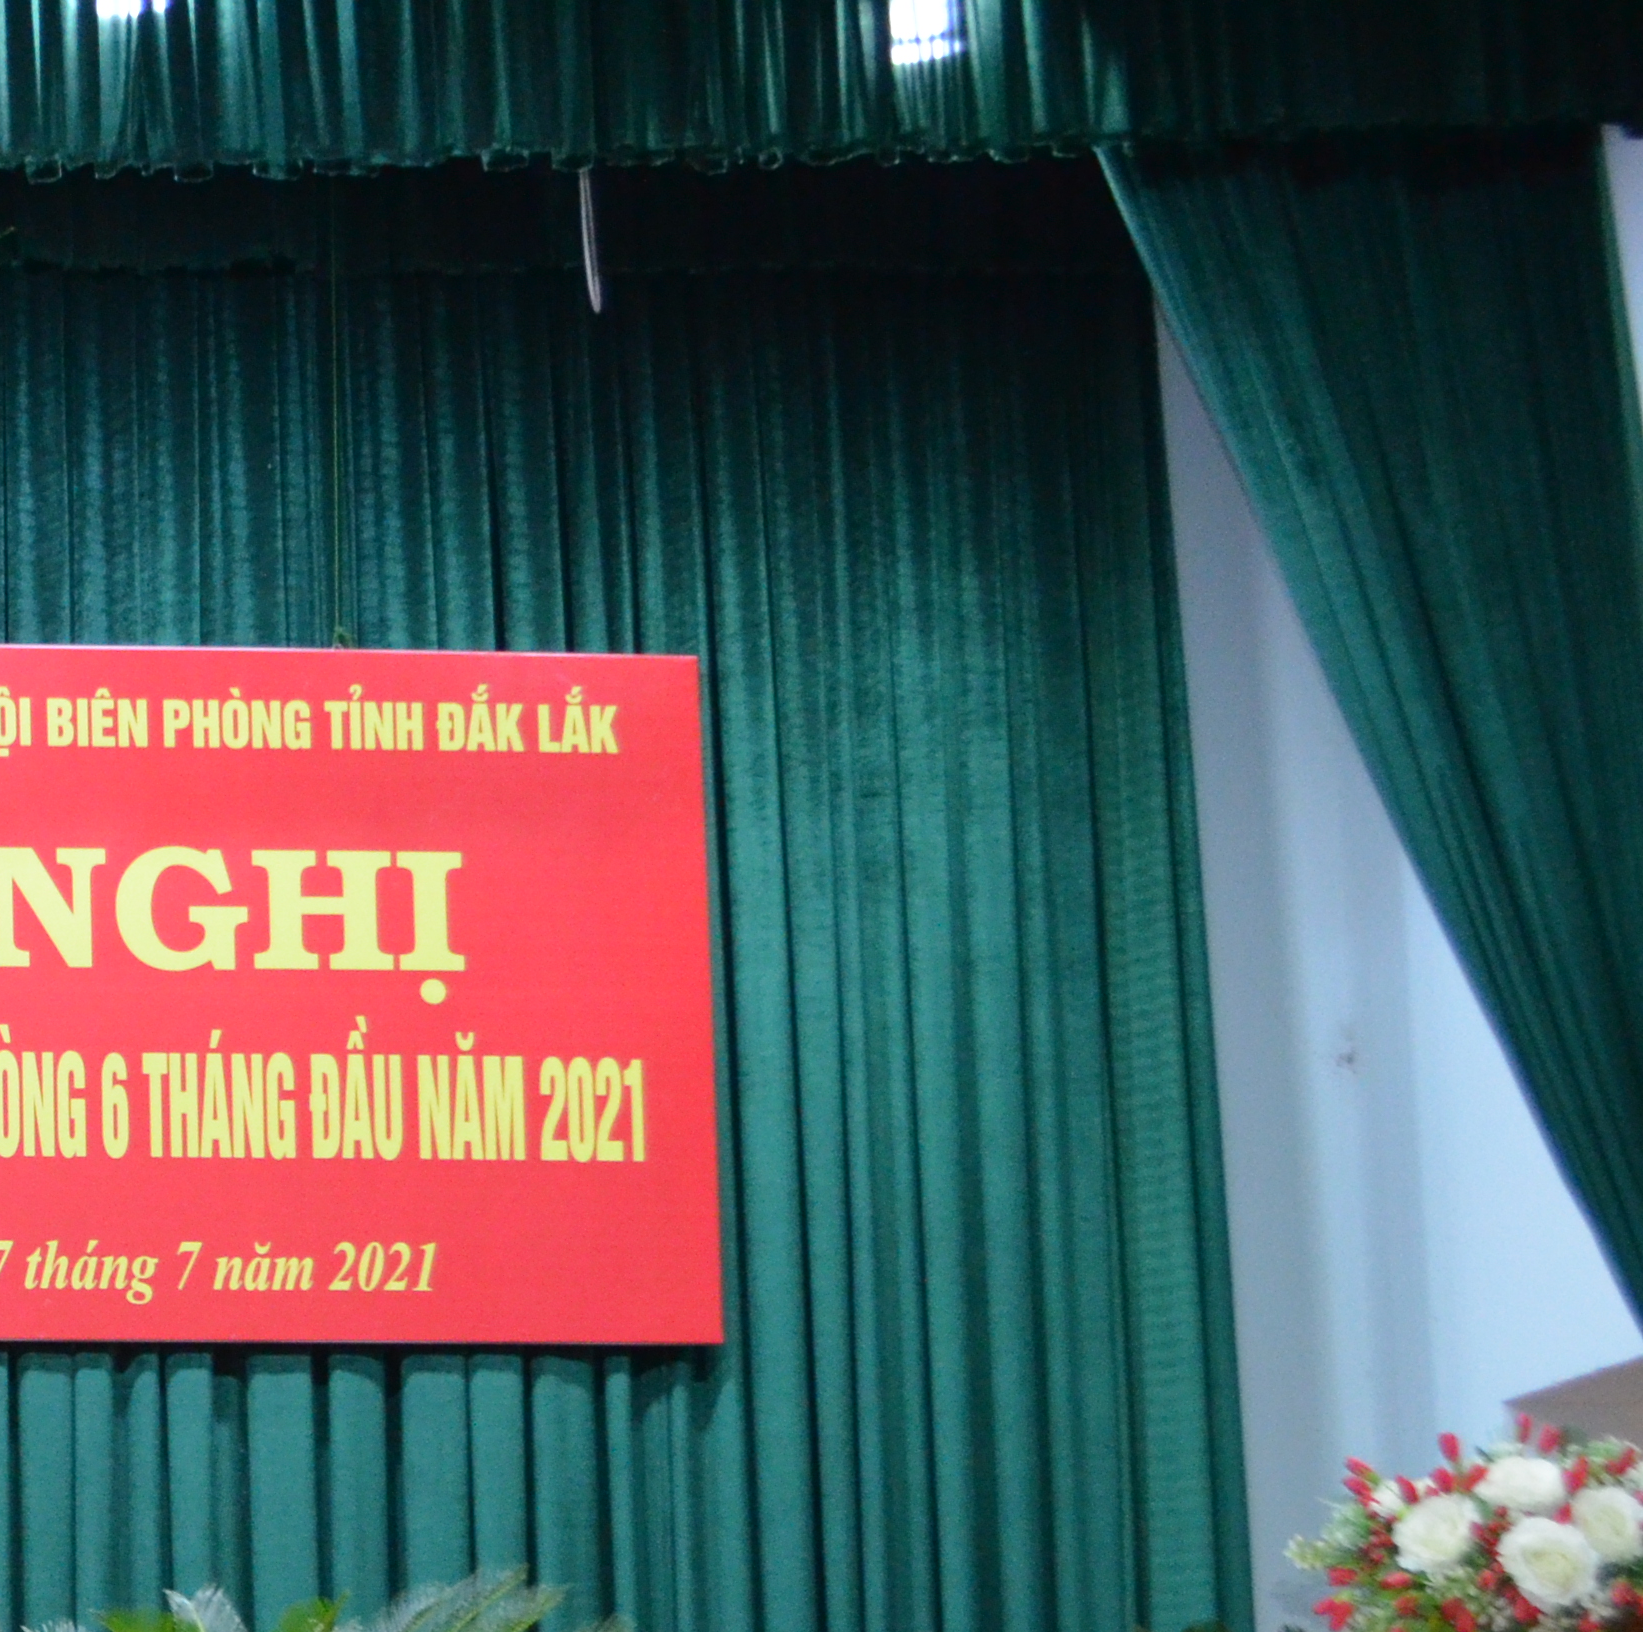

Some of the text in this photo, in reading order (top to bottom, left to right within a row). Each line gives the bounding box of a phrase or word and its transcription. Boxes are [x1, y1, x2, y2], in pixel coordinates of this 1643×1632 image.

[45, 686, 149, 749] BIÊN
[162, 684, 313, 751] PHÒNG
[323, 683, 425, 751] TỈNH
[435, 683, 526, 753] ĐẮK
[536, 685, 620, 755] LẮK
[100, 1051, 131, 1160] 6
[141, 1028, 298, 1161] THÁNG
[308, 1014, 404, 1161] ĐẦU
[416, 1031, 527, 1161] NĂM
[539, 1055, 648, 1163] 2021
[23, 1239, 160, 1305] tháng
[176, 1240, 203, 1291] 7
[212, 1241, 315, 1292] năm
[327, 1241, 438, 1292] 2021
